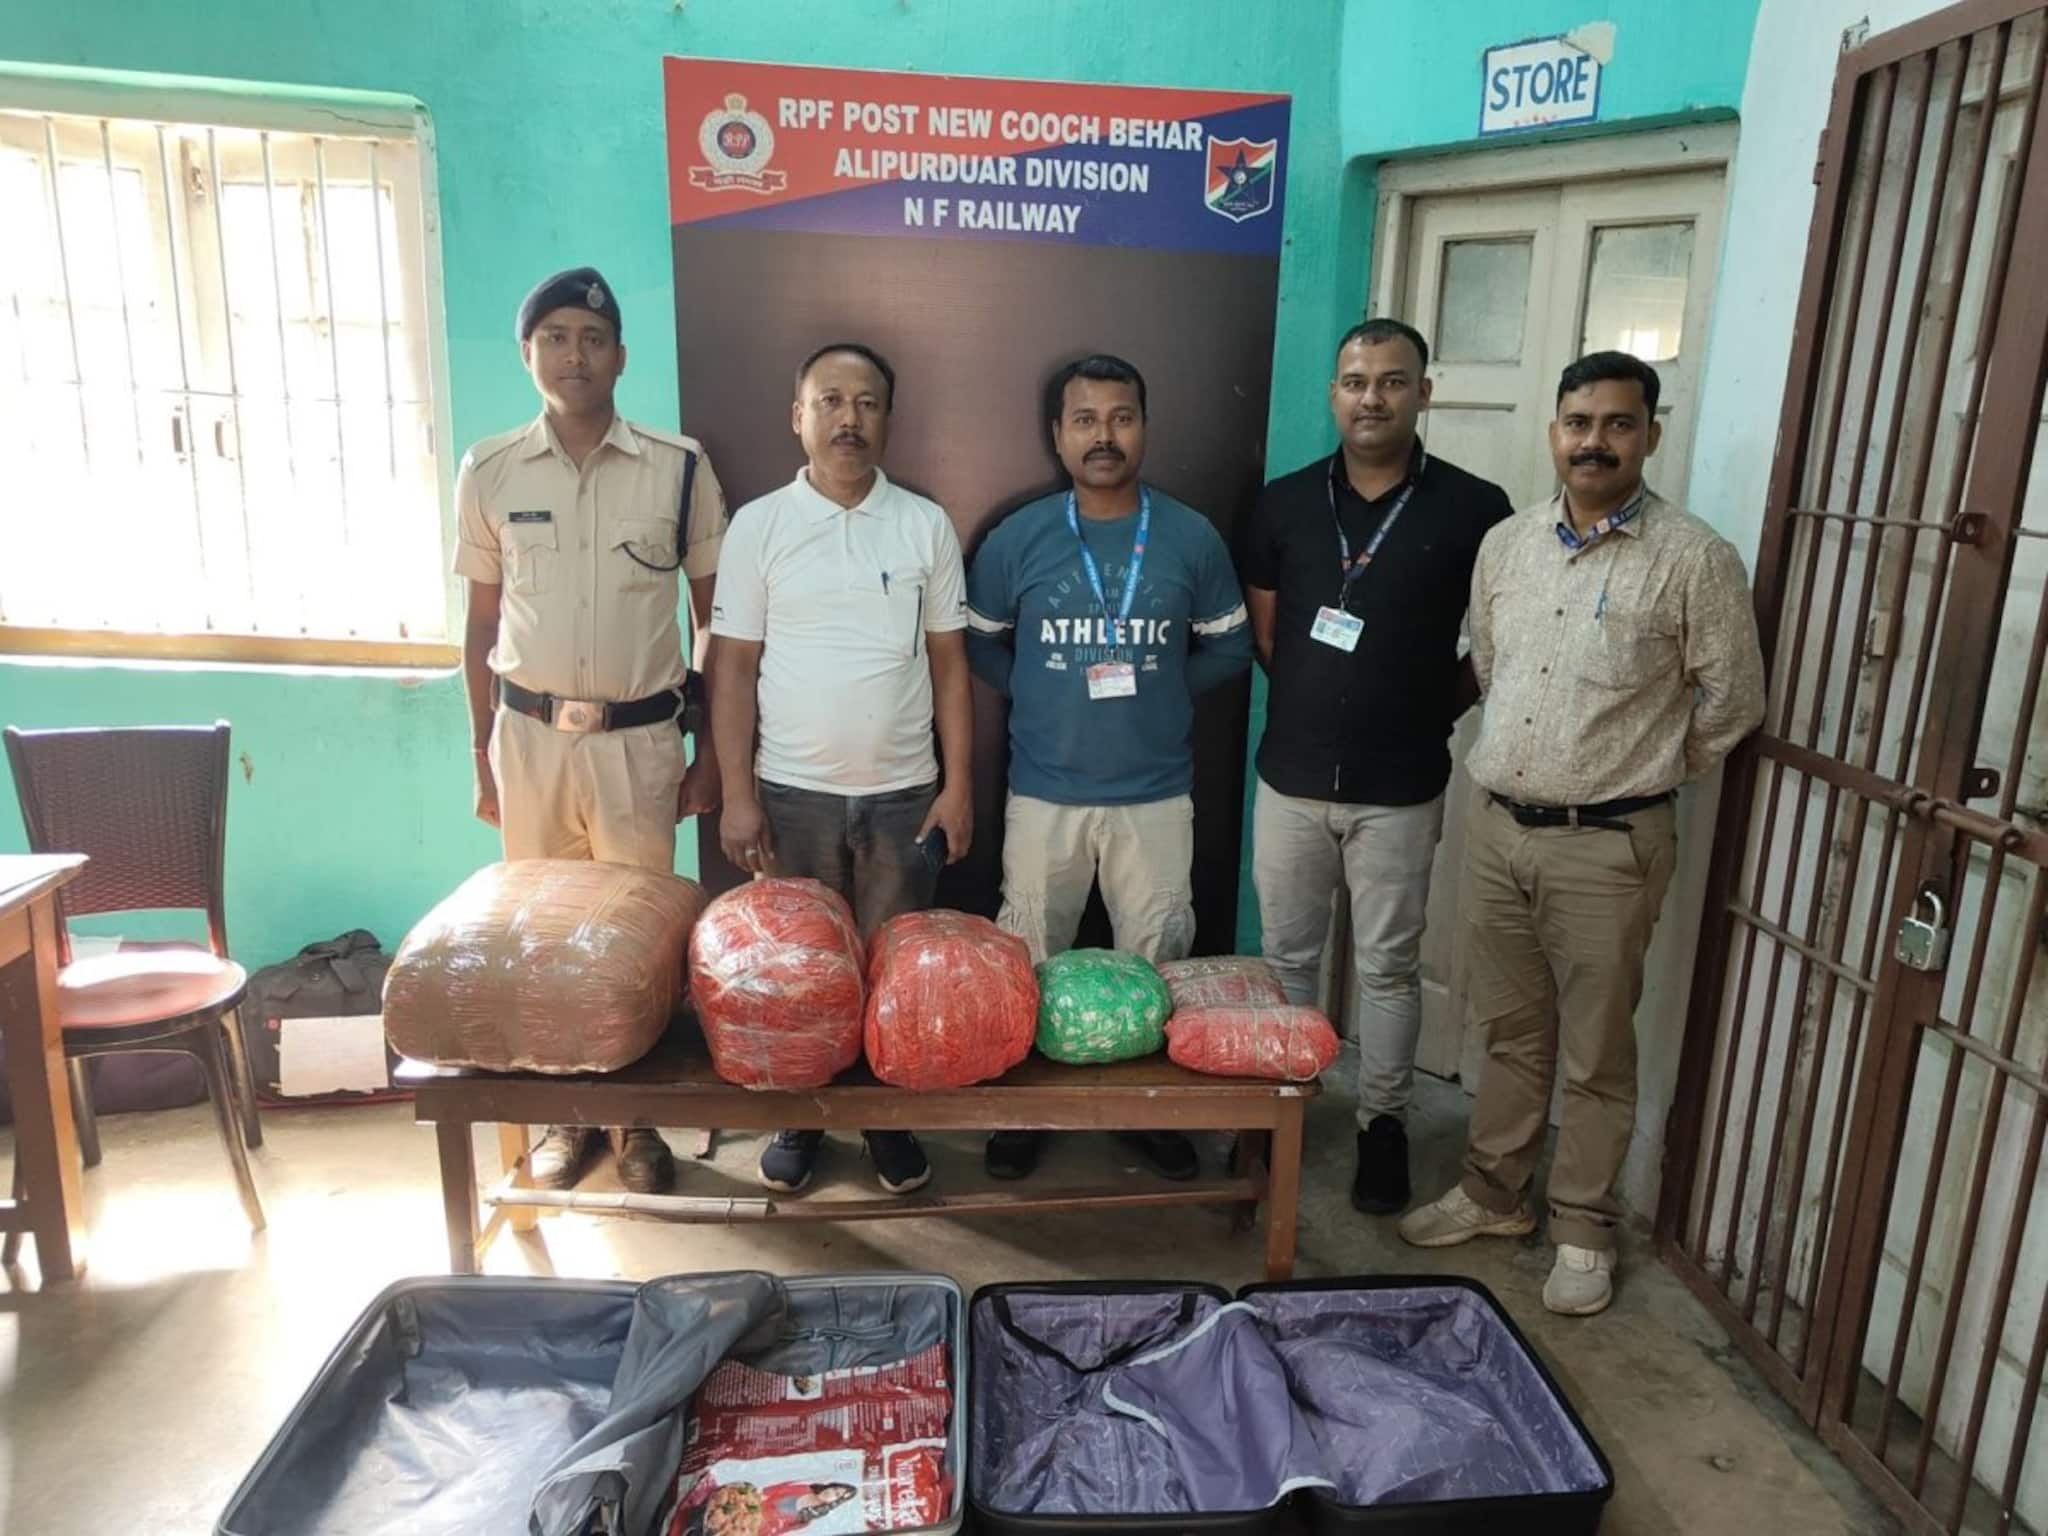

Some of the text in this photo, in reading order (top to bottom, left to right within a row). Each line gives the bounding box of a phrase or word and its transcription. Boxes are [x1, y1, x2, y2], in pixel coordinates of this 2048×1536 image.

[1489, 55, 1590, 112] STORE
[778, 97, 1203, 151] RPF POST NEW COOCH BEHAR
[834, 148, 1149, 193] ALIPURDUAR DIVISION
[904, 197, 1082, 233] N F RAILWAY
[1040, 617, 1172, 645] ATHLETIC
